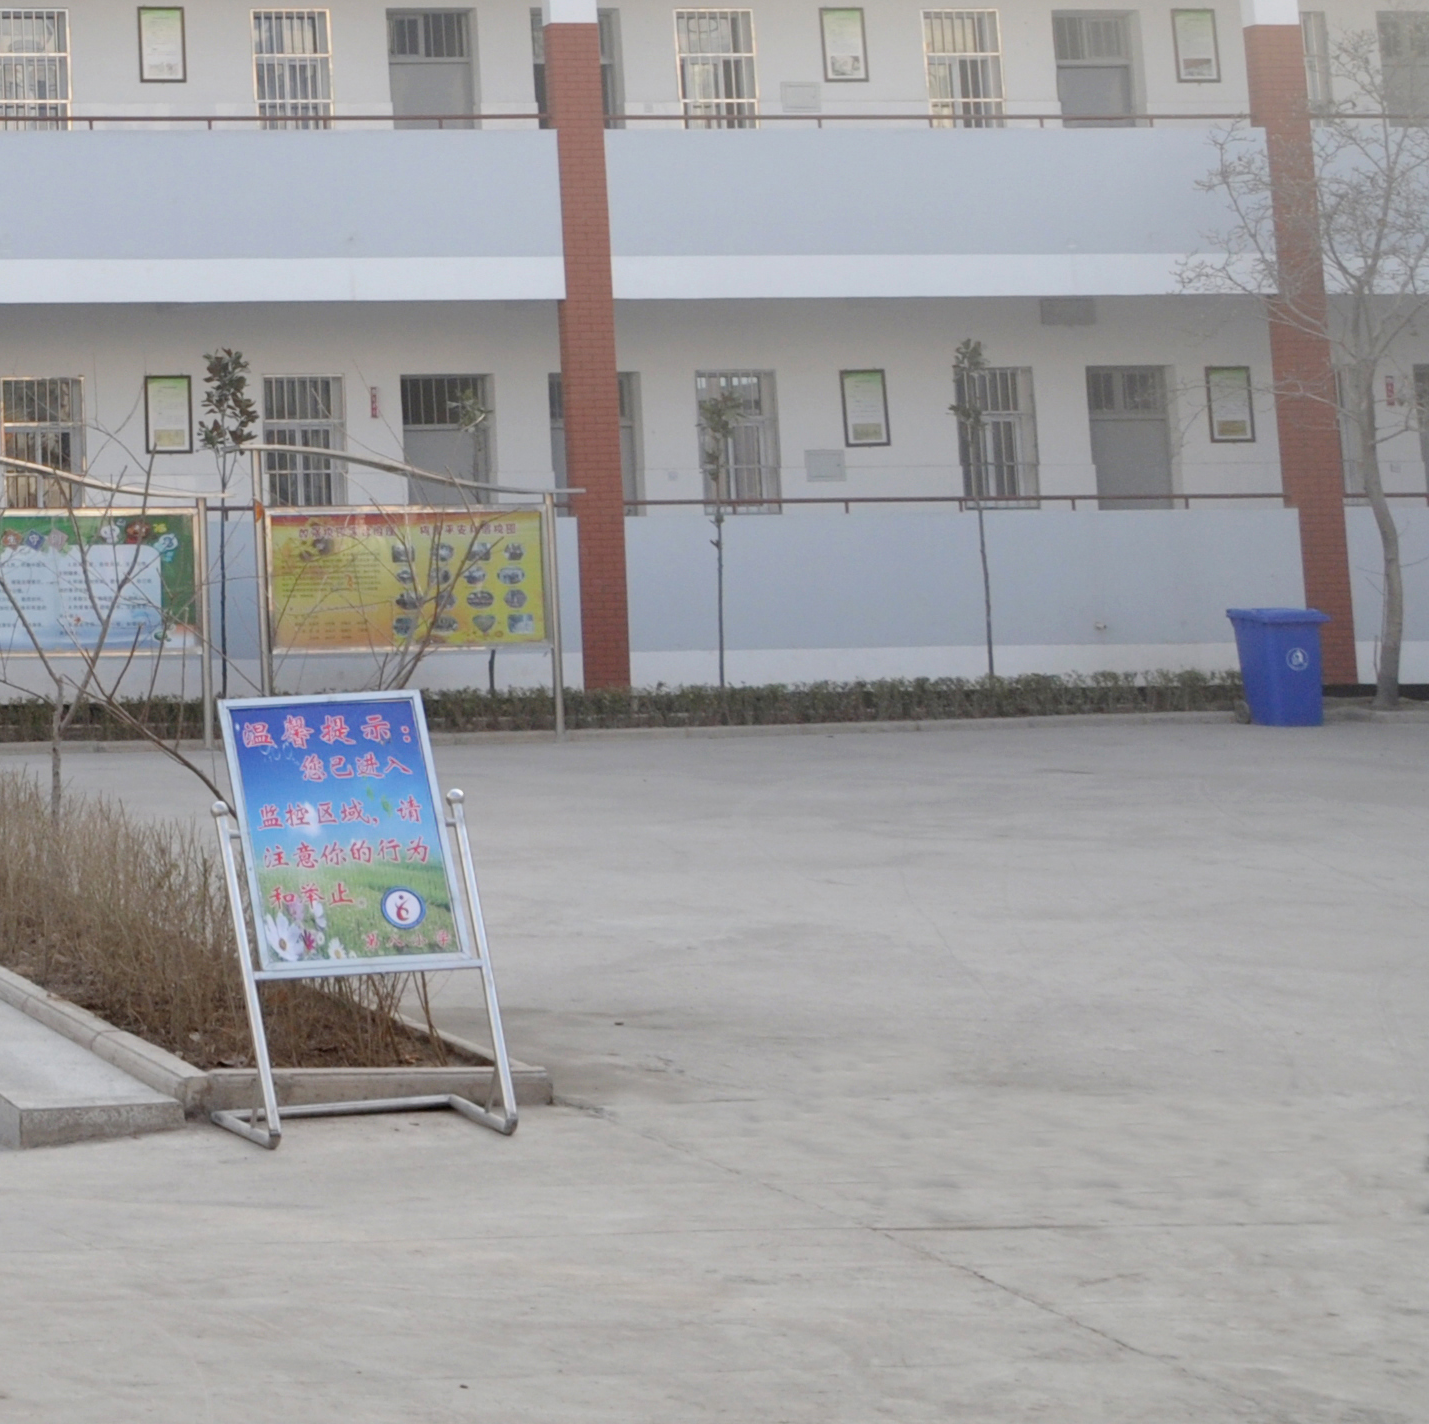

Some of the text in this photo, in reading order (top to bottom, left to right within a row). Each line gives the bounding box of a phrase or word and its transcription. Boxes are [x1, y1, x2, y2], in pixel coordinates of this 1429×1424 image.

[257, 795, 423, 831] 监控区域，请
[262, 836, 431, 870] 注意你的行为
